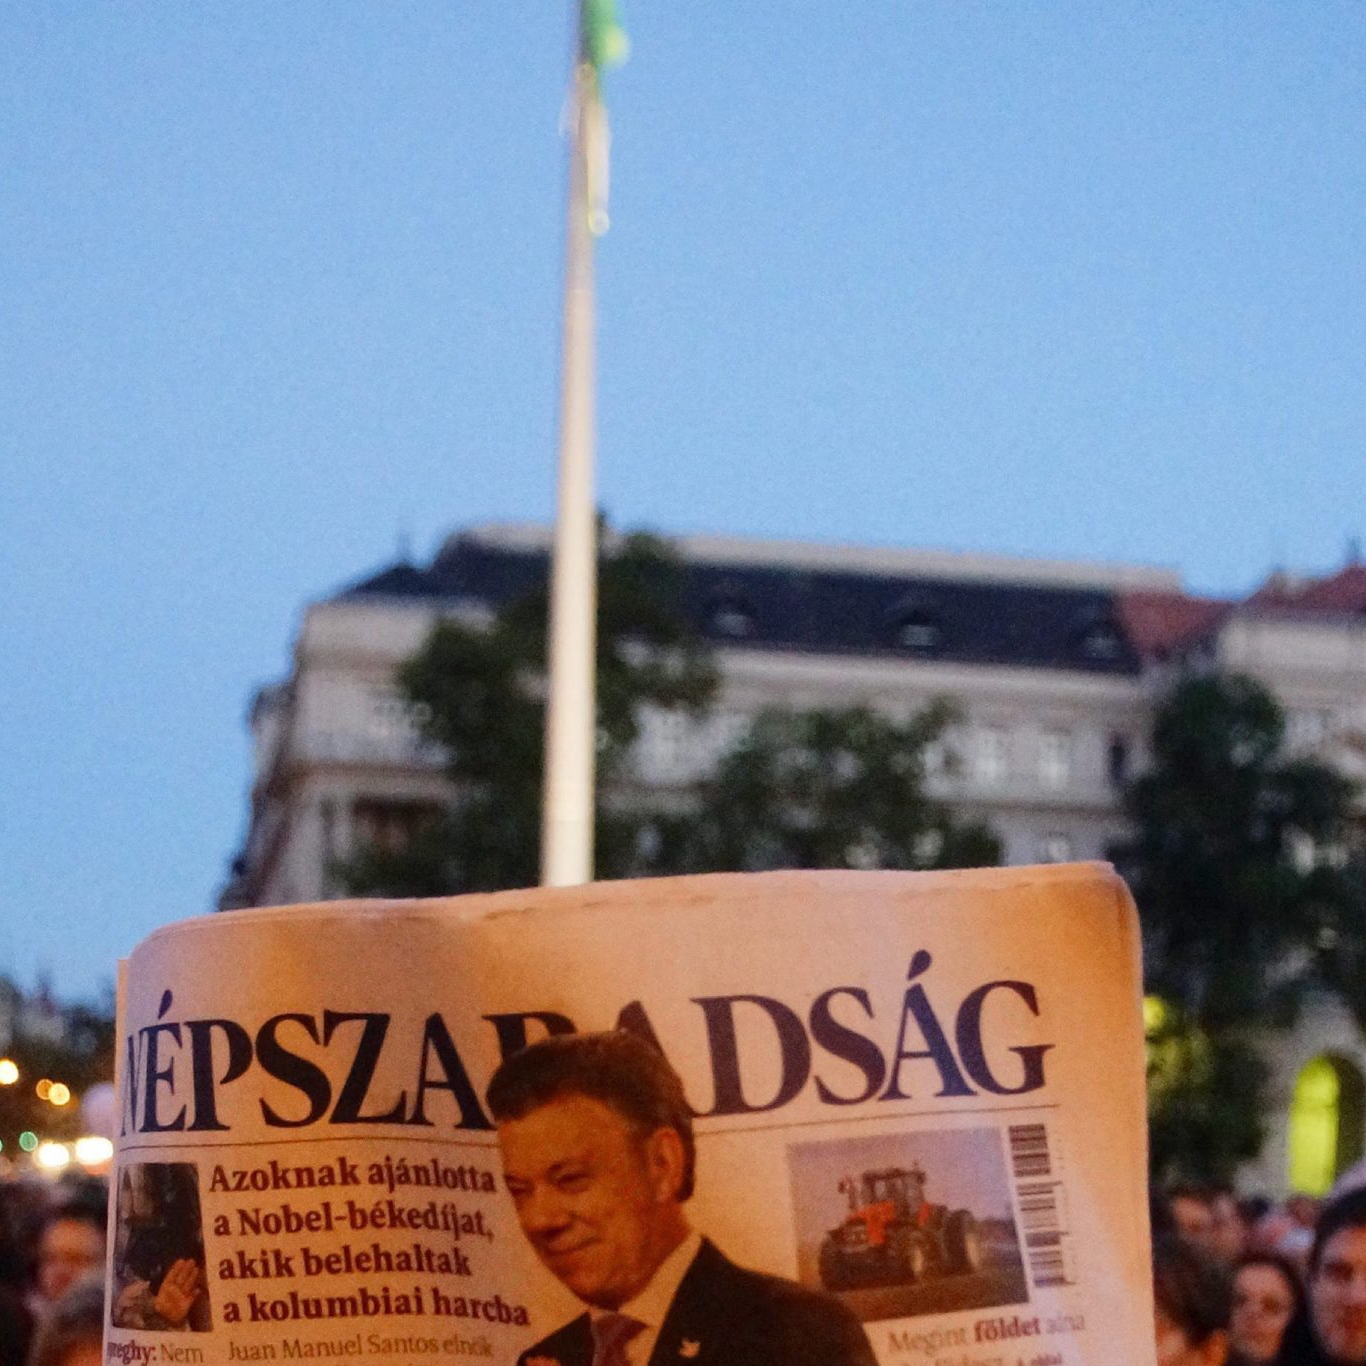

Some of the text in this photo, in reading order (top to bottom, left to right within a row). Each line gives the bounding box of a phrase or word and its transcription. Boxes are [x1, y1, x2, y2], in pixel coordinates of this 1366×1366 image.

[119, 950, 1056, 1136] NÉPSZADSÁG
[209, 1155, 497, 1194] Azoknak ajánlotta
[213, 1200, 495, 1242] a Nobel-békedíjat,
[218, 1244, 473, 1280] akik belehaltak
[222, 1287, 532, 1328] a kolumbiai harcba
[228, 1340, 277, 1361] Juan
[282, 1333, 363, 1360] Manuel
[366, 1333, 440, 1356] Santos
[973, 1315, 1041, 1344] földet
[160, 1343, 205, 1363] Nem
